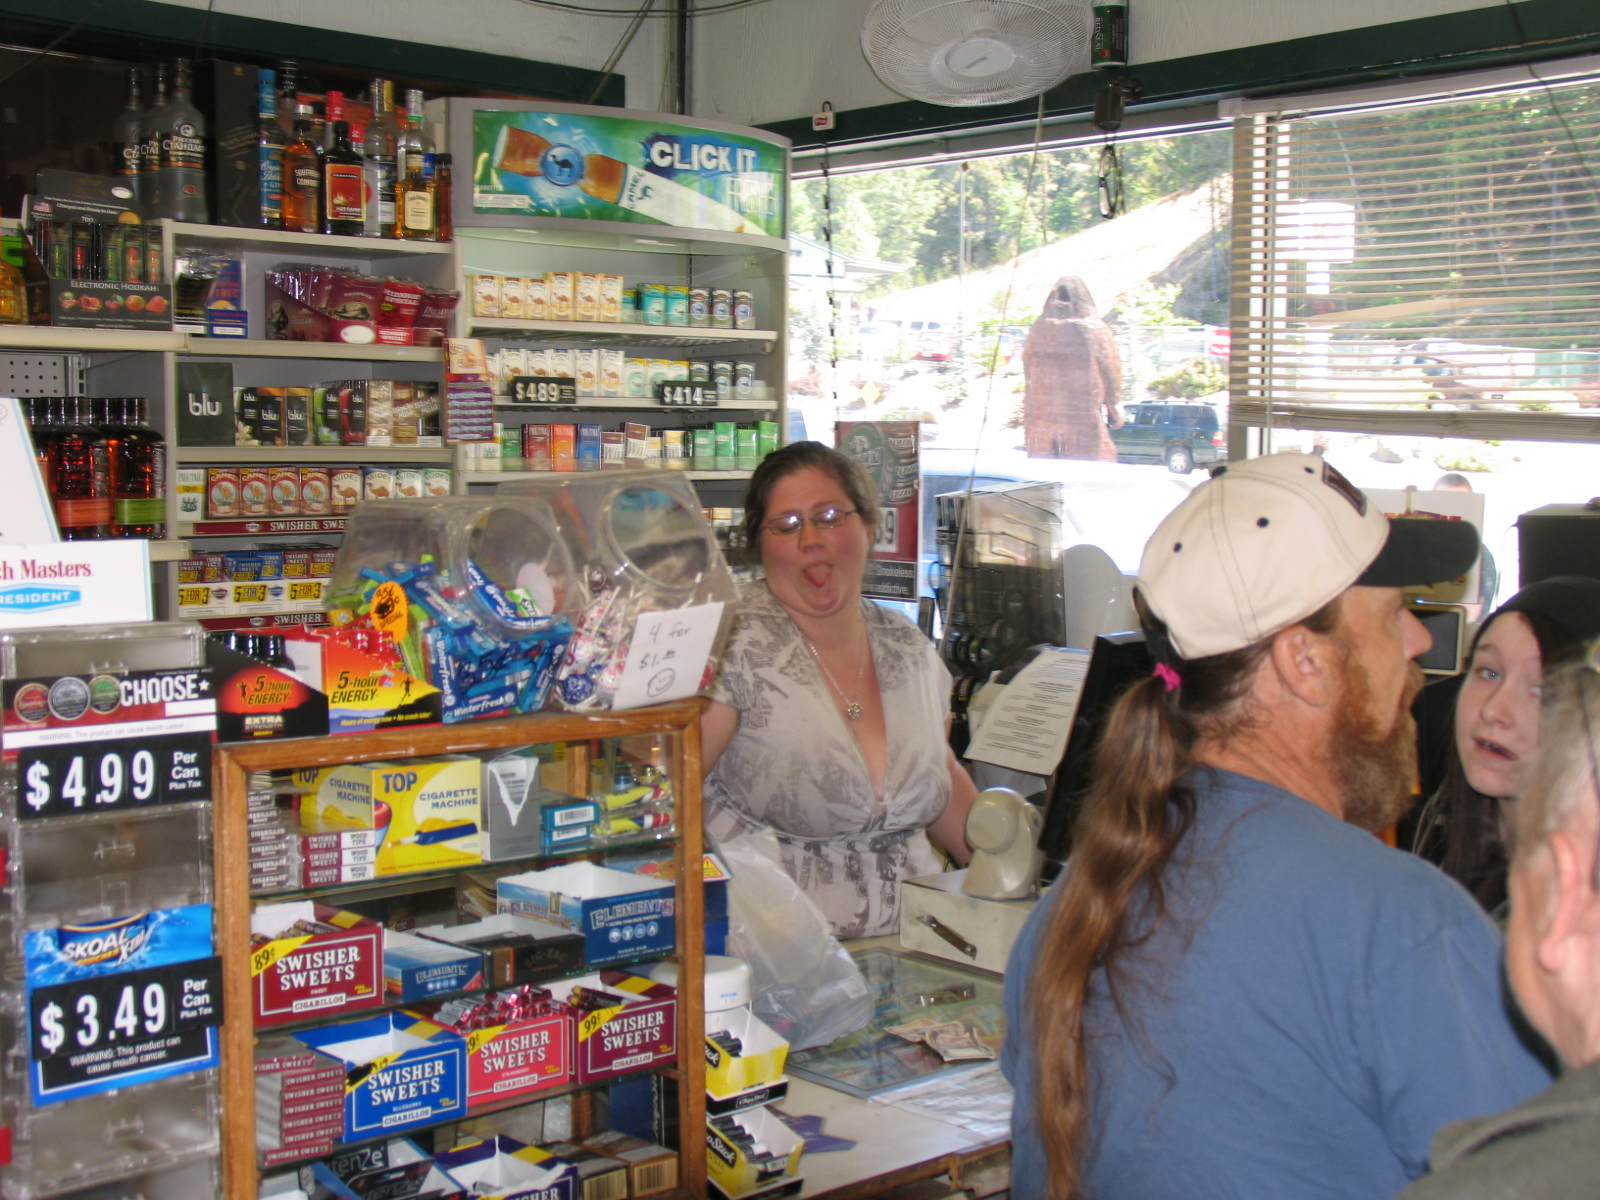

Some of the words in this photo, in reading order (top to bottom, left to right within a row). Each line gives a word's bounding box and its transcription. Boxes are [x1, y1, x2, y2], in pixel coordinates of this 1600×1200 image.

[650, 140, 731, 172] CLICK
[736, 147, 757, 173] IT
[71, 280, 118, 290] ELECTRONIC
[121, 282, 156, 292] HOOKAH
[188, 392, 221, 416] blu
[244, 393, 255, 401] blu
[262, 409, 276, 420] blu
[288, 409, 302, 420] blu
[333, 473, 358, 482] WIDES
[367, 473, 392, 481] WIDES
[397, 472, 421, 481] WIDES
[424, 473, 449, 481] WIDES
[270, 521, 317, 531] SWISHER
[323, 520, 346, 530] SWE
[20, 560, 92, 580] Masters
[186, 590, 200, 600] FOR
[202, 587, 209, 604] 3
[234, 586, 241, 602] 5
[244, 587, 257, 597] FOR
[258, 585, 266, 602] 3
[290, 584, 298, 599] 5
[299, 585, 312, 595] FOR
[314, 583, 321, 598] 3
[274, 614, 321, 624] SWISHER
[649, 624, 660, 641] 4
[668, 624, 691, 640] for
[436, 640, 452, 695] Winterfresh
[254, 675, 290, 692] 5-hour
[338, 671, 379, 689] 5-hour
[120, 674, 199, 706] CHOOSE
[331, 689, 377, 704] ENERGY
[248, 692, 290, 705] ENERGY
[454, 698, 505, 717] Winterfresh
[245, 716, 283, 724] EXTRA
[362, 717, 378, 726] energy
[90, 728, 113, 738] product
[174, 752, 197, 764] Per
[172, 766, 199, 780] Can
[298, 766, 319, 784] TOP
[169, 782, 186, 790] Plus
[187, 780, 202, 788] Tax
[330, 777, 370, 794] CIGARETTE
[381, 772, 418, 794] TOP
[337, 790, 371, 805] MACHINE
[420, 788, 478, 802] CIGARETTE
[431, 798, 478, 810] MACHINE
[590, 898, 674, 930] ELEMENTS
[62, 927, 128, 961] SKOAL
[254, 947, 276, 970] 89¢
[276, 946, 361, 974] SWISHER
[280, 964, 355, 991] SWEETS
[184, 979, 207, 993] Per
[182, 994, 210, 1008] Can
[295, 996, 344, 1010] CIGARILLOS
[180, 1009, 197, 1019] Plus
[198, 1007, 212, 1015] Tax
[584, 1013, 601, 1034] 99¢
[601, 1011, 665, 1037] SWISHER
[480, 1030, 550, 1058] SWISHER
[604, 1028, 660, 1051] SWEETS
[70, 1049, 115, 1066] WARNING:
[116, 1046, 133, 1056] This
[135, 1040, 165, 1053] product
[167, 1037, 181, 1046] can
[87, 1062, 111, 1073] cause
[113, 1057, 139, 1068] mouth
[254, 1061, 280, 1071] WISHER
[282, 1060, 311, 1068] SWEETS
[484, 1047, 546, 1074] SWEETS
[614, 1054, 652, 1068] CIGARILLOS
[286, 1074, 316, 1085] SWISHER
[317, 1069, 343, 1079] SWEETS
[368, 1060, 445, 1090] SWISHER
[284, 1089, 315, 1099] SWISHER
[316, 1084, 343, 1094] SWEETS
[495, 1075, 536, 1092] CIGARILLOS
[372, 1078, 440, 1106] SWEETS
[285, 1104, 316, 1114] SWISHER
[317, 1099, 342, 1109] SWEETS
[283, 1118, 313, 1128] SWISHER
[314, 1113, 341, 1123] SWEETS
[384, 1109, 429, 1125] CIGARILLOS
[285, 1132, 316, 1143] SWISHER
[317, 1126, 342, 1137] SWEETS
[267, 1150, 299, 1161] SWISHER
[301, 1145, 328, 1155] SWEETS
